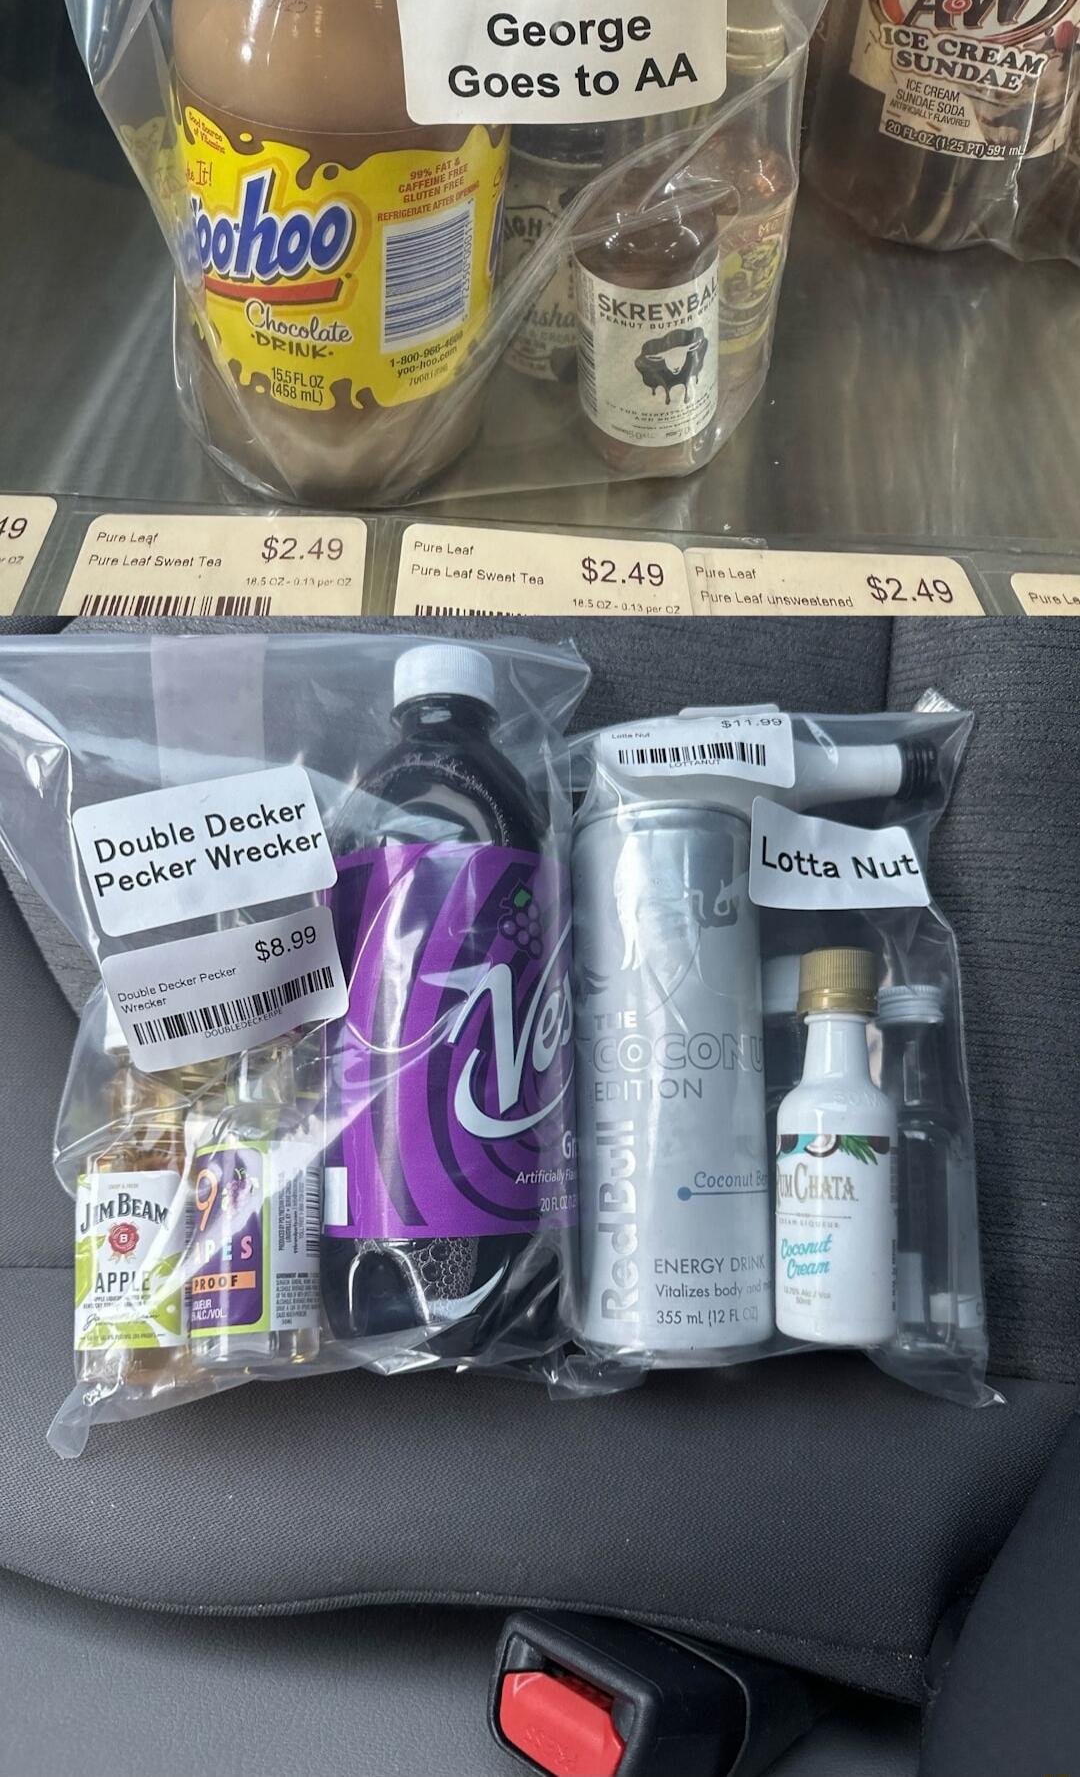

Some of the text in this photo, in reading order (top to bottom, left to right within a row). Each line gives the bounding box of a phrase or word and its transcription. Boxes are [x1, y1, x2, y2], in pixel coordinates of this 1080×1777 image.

[486, 13, 652, 53] George
[882, 26, 1046, 76] ICE CREAM
[448, 52, 699, 99] Goes to AA
[896, 50, 1023, 92] SUNDAE
[889, 98, 971, 128] ARTIFICIALLY FLAVORED
[887, 122, 1025, 157] 20 FL OZ (1.25 PT) 591 mL
[398, 163, 469, 194] CAFFEINE FREE
[403, 176, 465, 204] GLUTEN FREE
[598, 276, 719, 322] SKREWBAL
[245, 299, 353, 343] Chocolate
[600, 313, 693, 330] PEANUT BUTTER
[255, 332, 328, 359] DRINK
[272, 384, 324, 406] (458 mL)
[88, 554, 222, 568] Pure Leaf Sweet Tea
[261, 535, 344, 564] $2.49
[581, 557, 665, 587] $2.49
[700, 590, 854, 609] Pure Leaf unsweetened
[867, 575, 954, 604] $2.49
[721, 717, 783, 729] $11.99
[93, 802, 306, 864] Double Decker
[94, 831, 323, 897] Pecker Wrecker
[760, 835, 920, 880] Lotta Nut
[254, 925, 318, 964] $8.99
[117, 966, 238, 1003] Double Decker Pecker
[121, 997, 168, 1015] Wrecker
[593, 1032, 764, 1072] COCONU
[594, 1077, 704, 1103] EDITION
[515, 1168, 565, 1185] Artificially
[693, 1171, 754, 1189] Coconut
[80, 1192, 169, 1233] JIM BEAM
[781, 1233, 833, 1260] Coconut
[654, 1254, 766, 1275] ENERGY DRINK
[787, 1259, 830, 1279] Cream
[193, 1274, 239, 1292] PROOF
[655, 1281, 744, 1300] Vitalizes body
[656, 1310, 704, 1326] 355 mL
